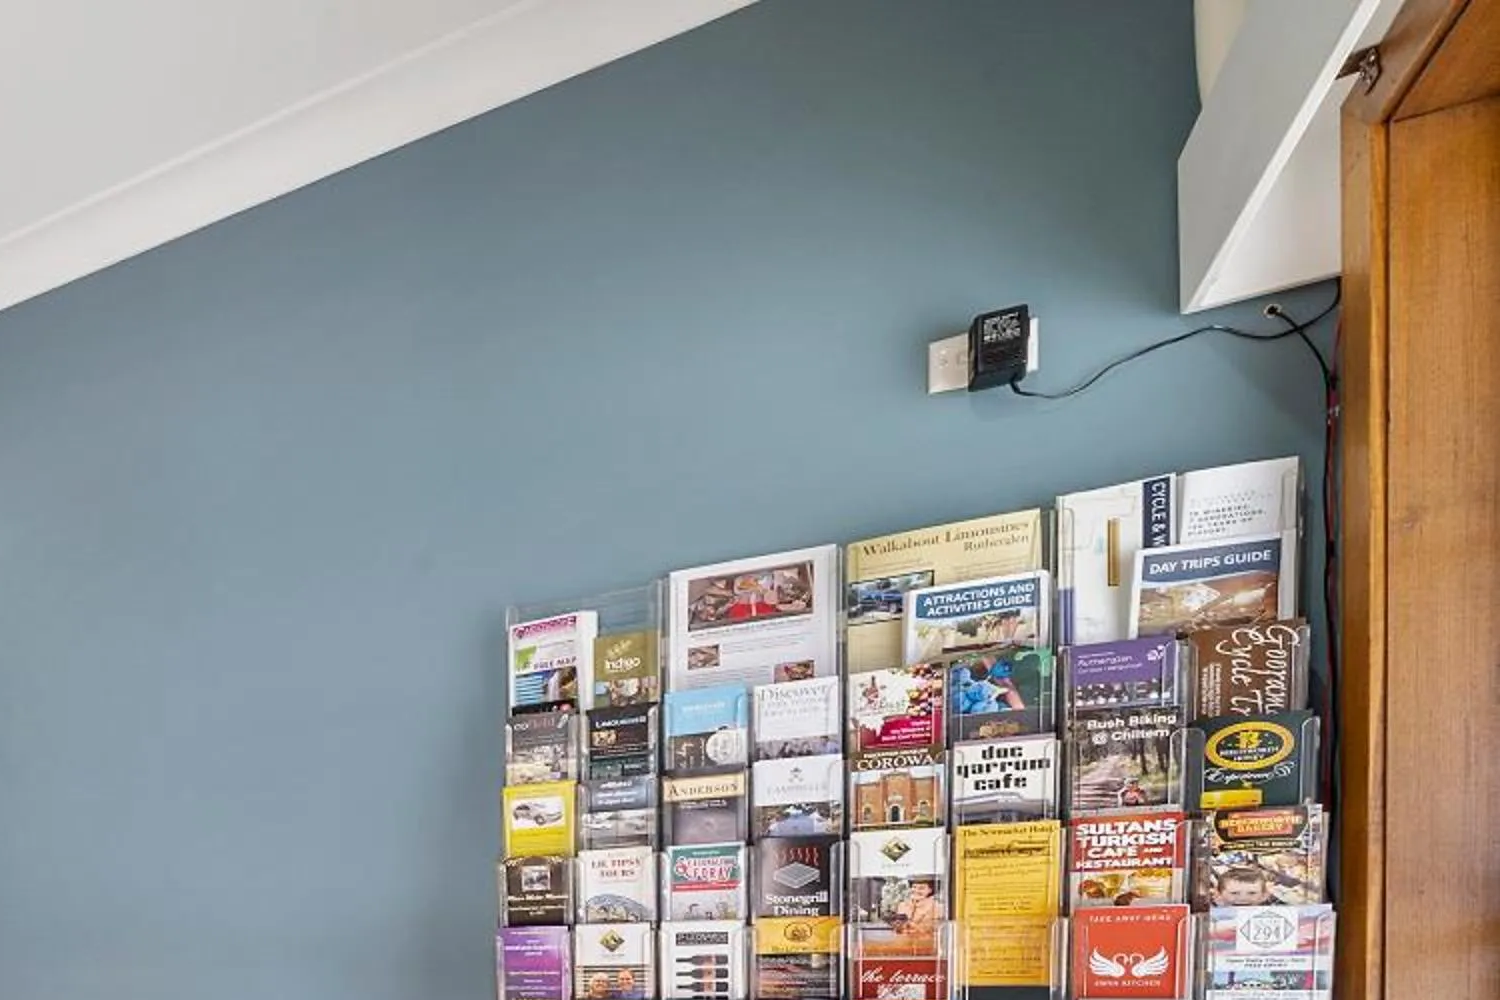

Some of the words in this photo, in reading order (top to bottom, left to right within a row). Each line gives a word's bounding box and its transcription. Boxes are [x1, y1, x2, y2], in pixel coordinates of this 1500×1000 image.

[1151, 482, 1167, 521] CYCLE
[1150, 560, 1177, 575] DAY
[1182, 555, 1219, 571] TRIPS
[1223, 550, 1272, 566] GUIDE
[923, 585, 1005, 606] ATTRACTIONS
[1007, 582, 1035, 596] AND
[926, 600, 991, 617] ACTIVITIES
[993, 593, 1033, 608] GUIDE
[1215, 626, 1266, 686] Cycle
[1087, 718, 1125, 731] Bush
[1129, 714, 1177, 727] Biking
[857, 754, 934, 771] COROWA
[974, 773, 1027, 790] cafe
[1076, 818, 1177, 836] SULTANS
[1076, 832, 1174, 848] TURKISH
[1076, 857, 1172, 869] RESTAURANT
[765, 891, 829, 905] Stonegrill
[774, 904, 819, 916] Dining
